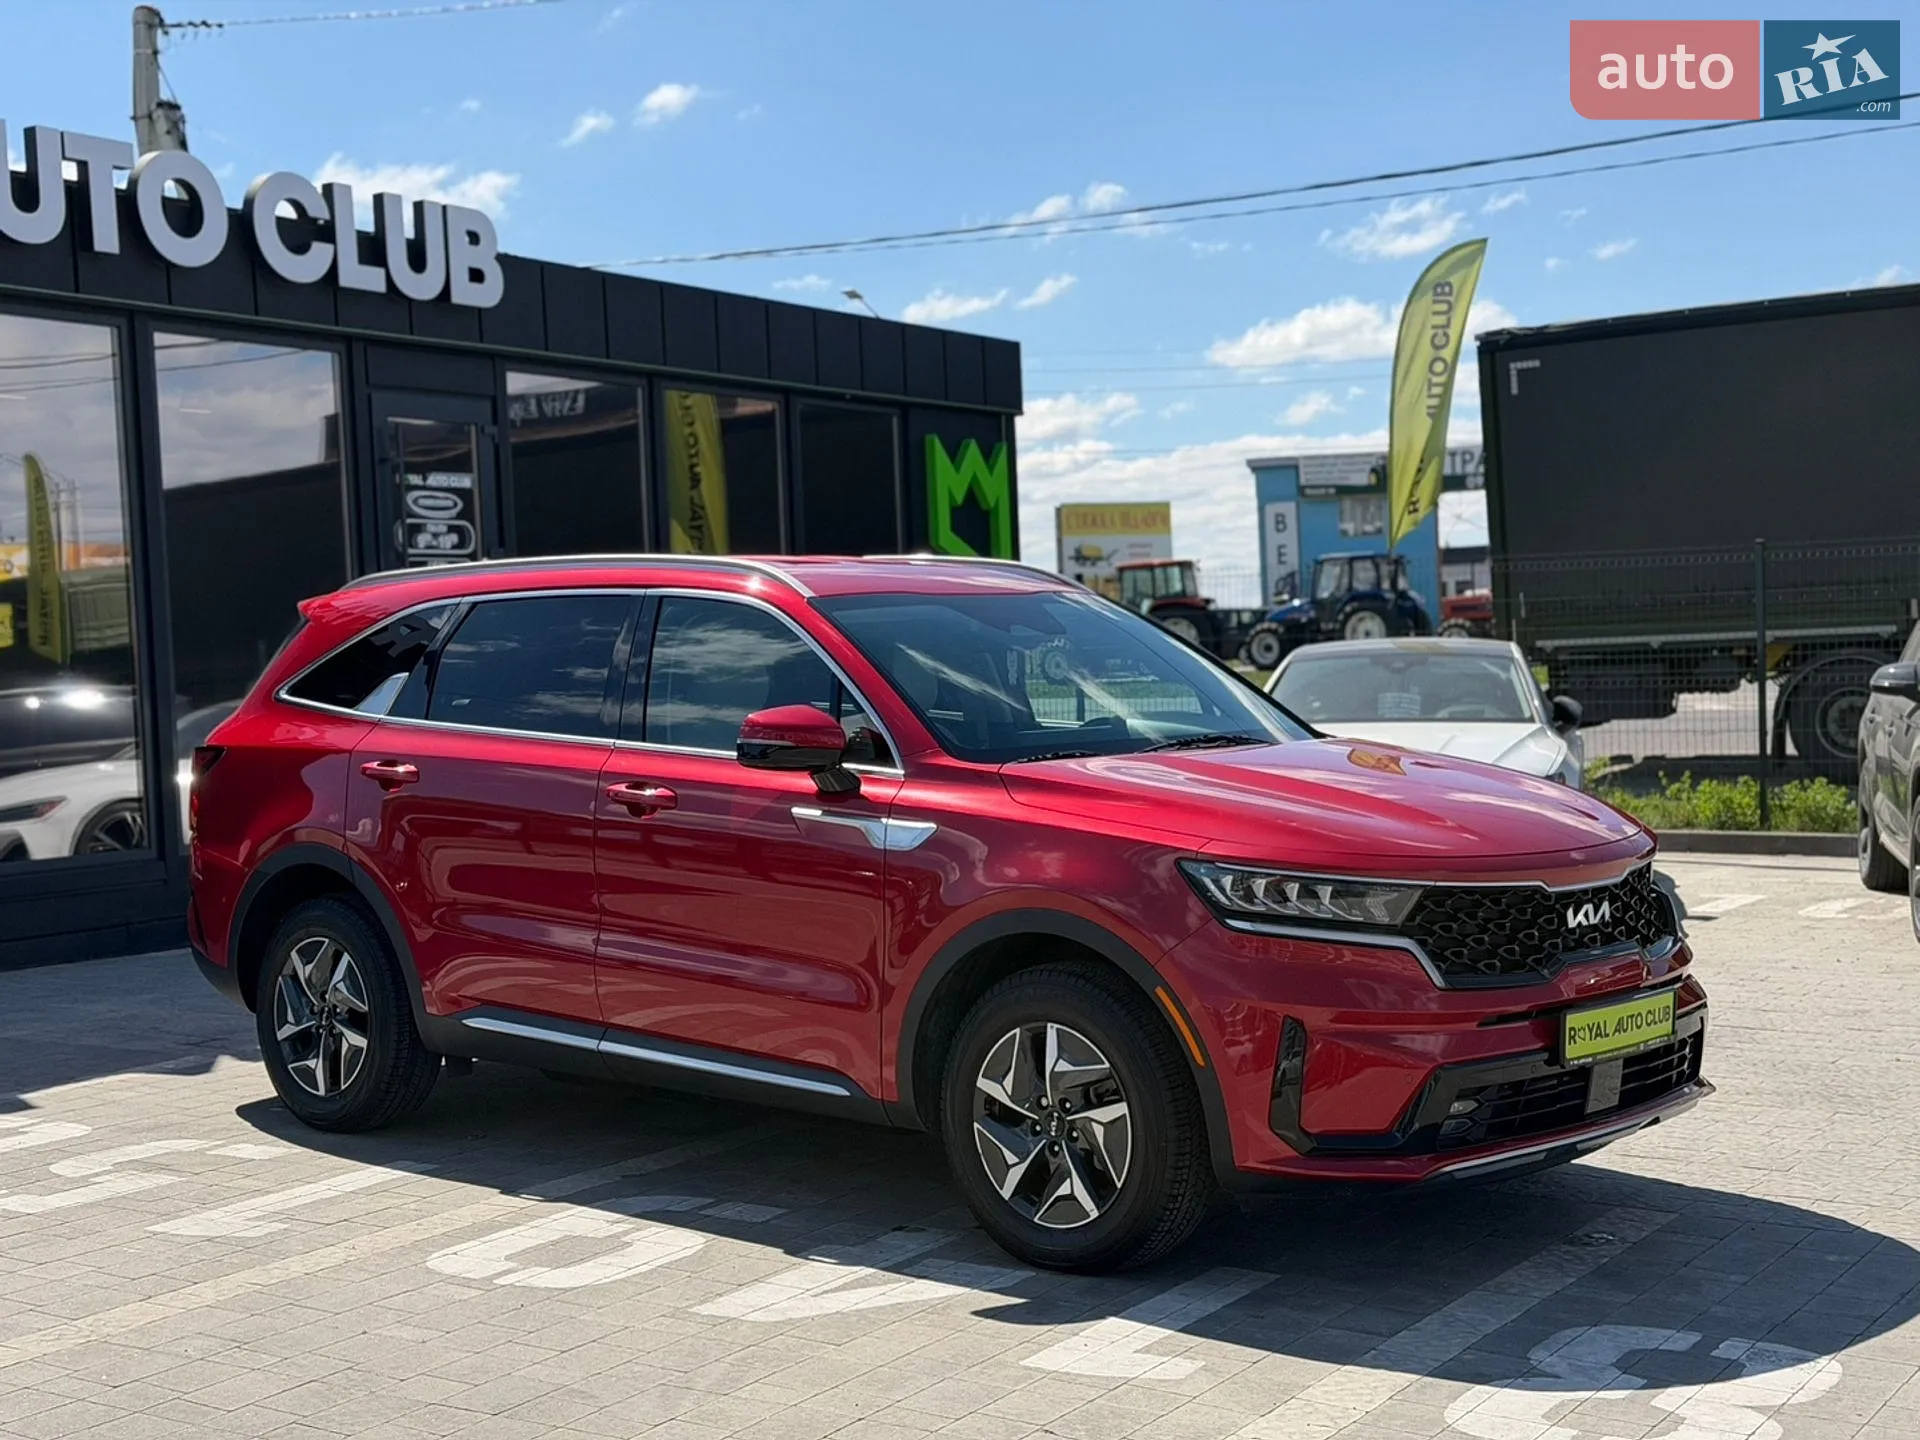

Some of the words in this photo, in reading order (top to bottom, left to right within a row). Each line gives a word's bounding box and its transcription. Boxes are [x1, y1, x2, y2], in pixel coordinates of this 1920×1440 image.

[250, 171, 504, 308] CLUB
[1431, 280, 1454, 348] CLUB
[1566, 901, 1611, 928] KIA
[1612, 1013, 1643, 1037] AUTO
[1645, 1005, 1671, 1028] CLUB
